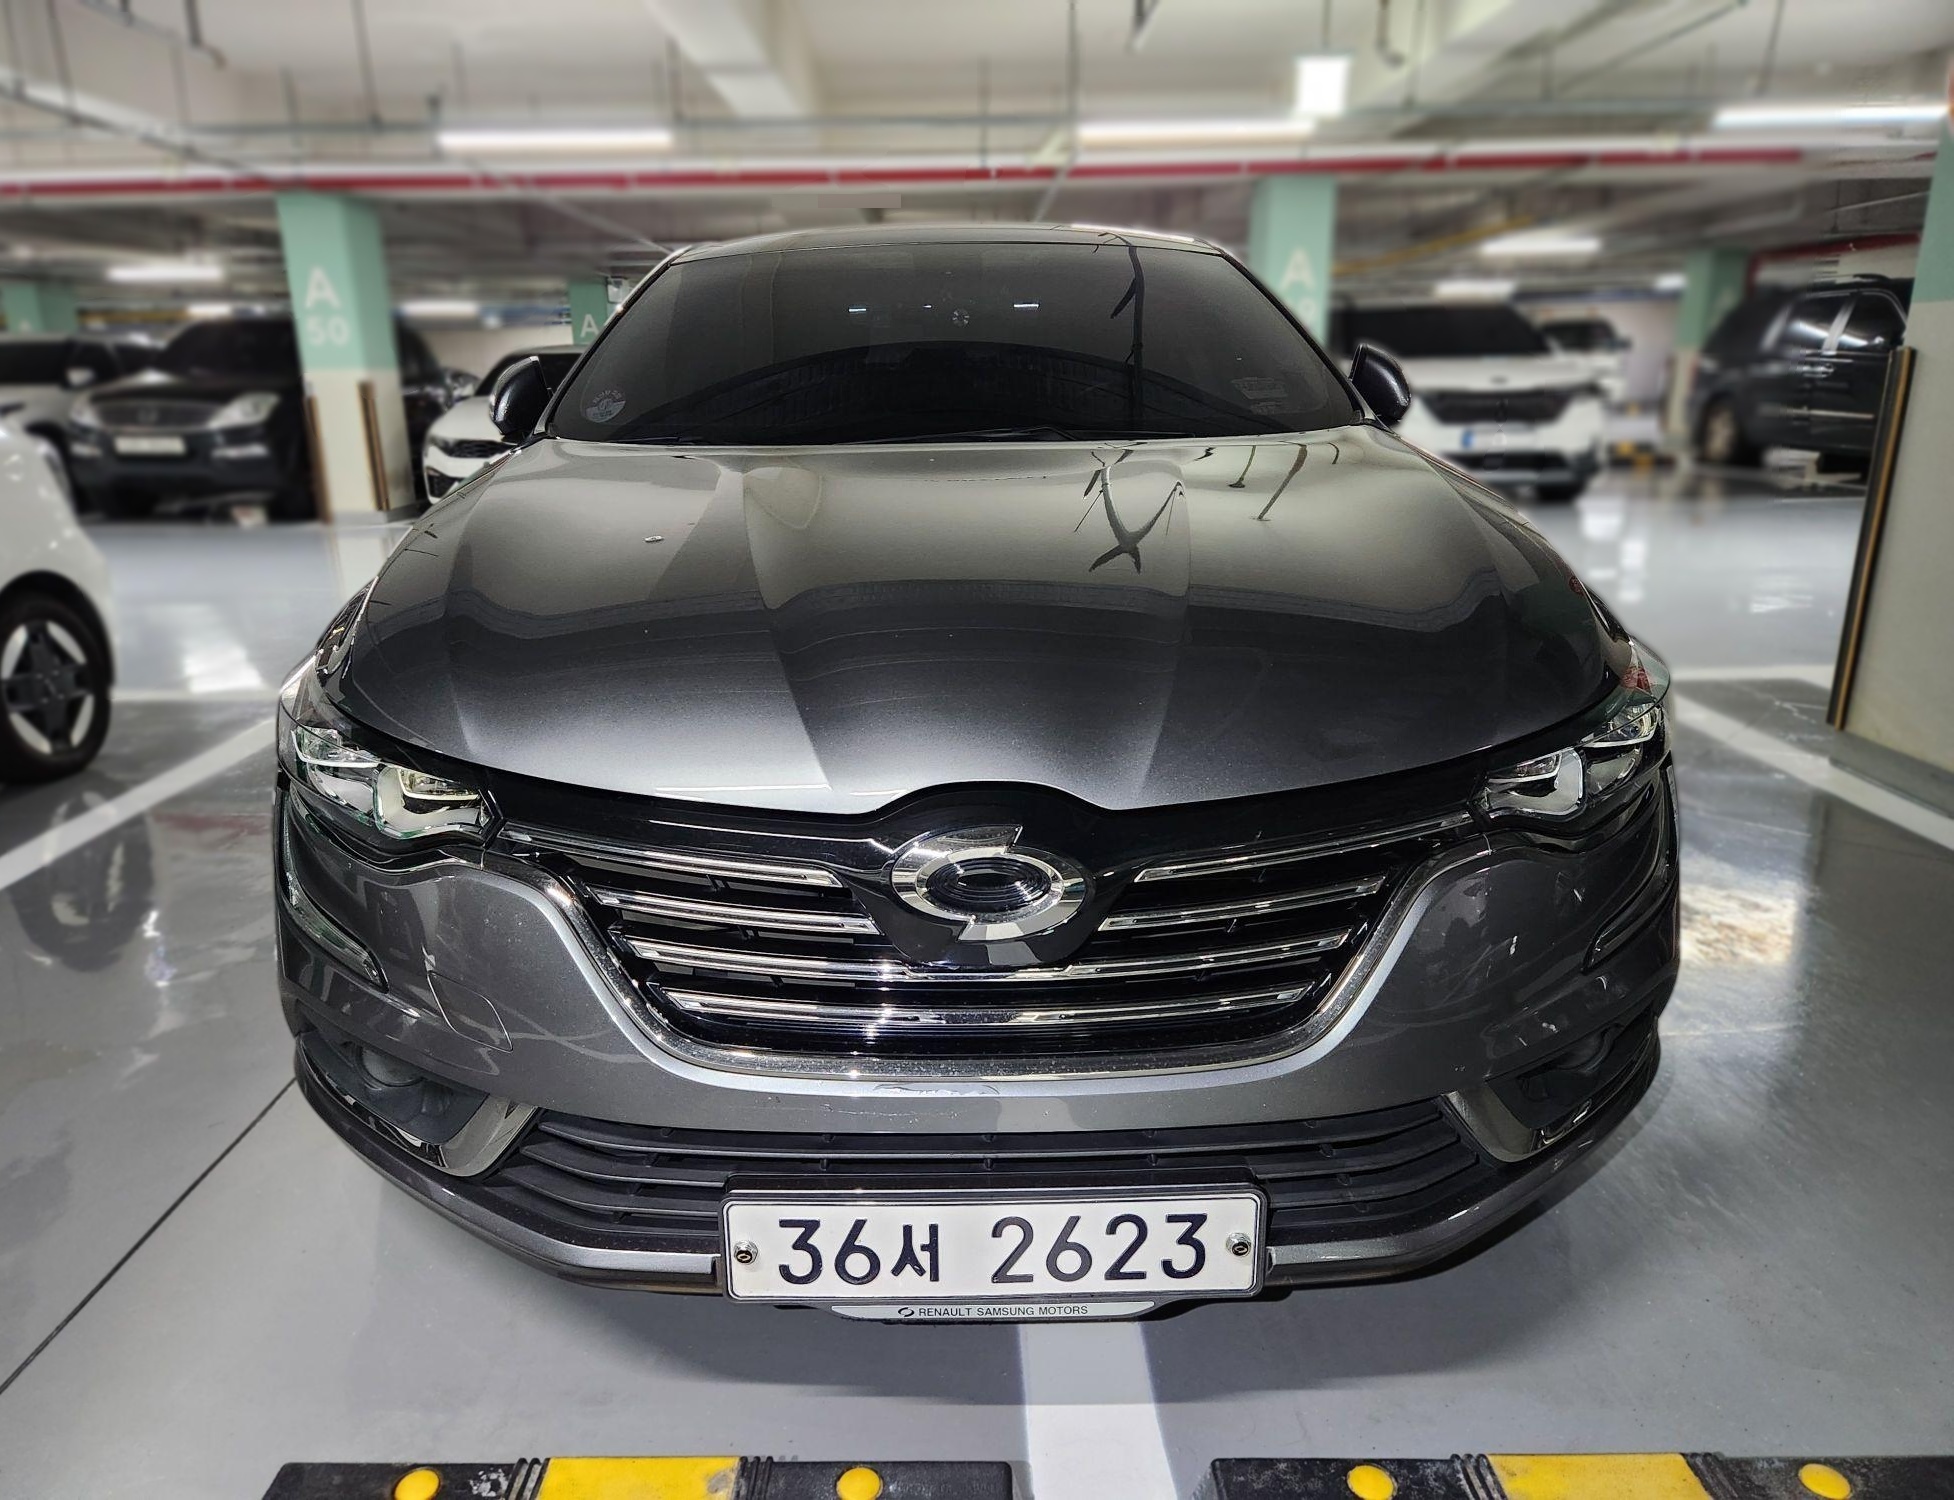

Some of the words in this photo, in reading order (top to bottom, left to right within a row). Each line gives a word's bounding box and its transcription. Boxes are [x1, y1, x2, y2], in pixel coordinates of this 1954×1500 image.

[305, 267, 341, 308] A
[581, 313, 600, 338] A
[778, 1218, 940, 1286] 36서
[991, 1213, 1208, 1284] 2623
[918, 1306, 973, 1317] RENAULT
[976, 1306, 1035, 1317] SAMSUNG
[1038, 1305, 1089, 1316] MOTORS
